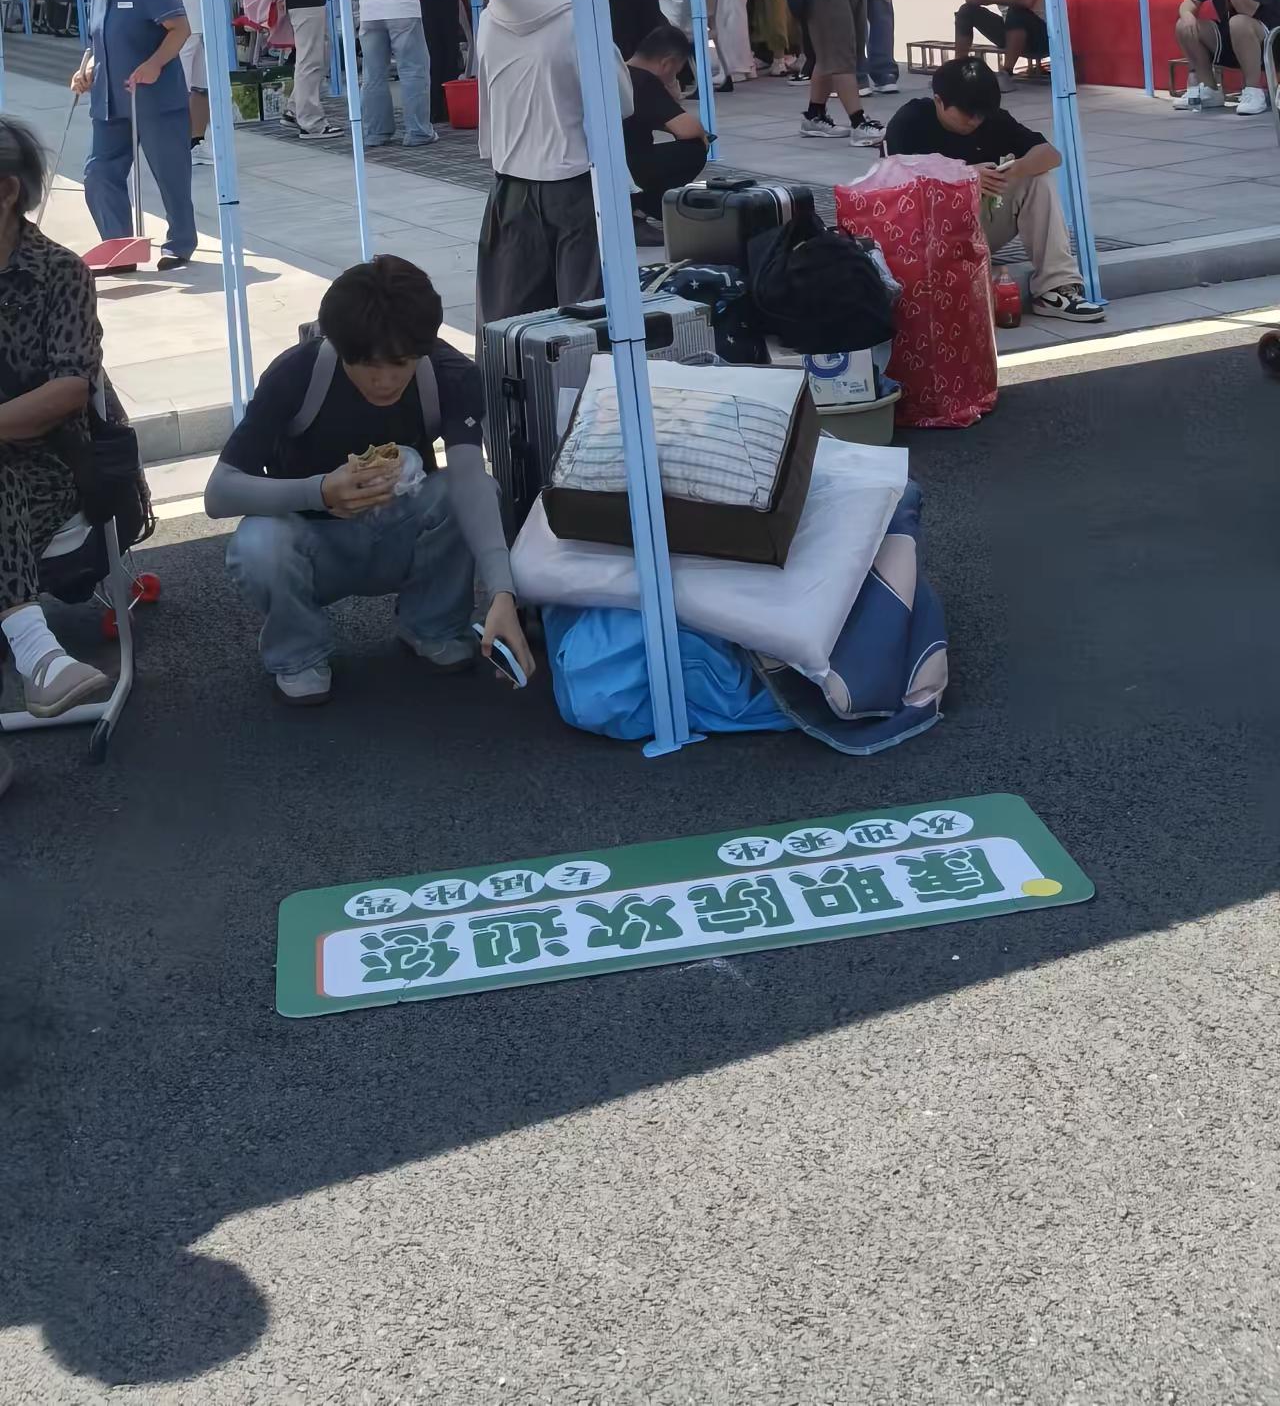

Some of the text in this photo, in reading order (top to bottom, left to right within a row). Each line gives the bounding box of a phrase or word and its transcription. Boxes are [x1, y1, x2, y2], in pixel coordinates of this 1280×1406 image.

[717, 811, 962, 862] 欢迎乘坐
[354, 865, 602, 916] 专属座驾
[358, 844, 1006, 984] 康职院欢迎您
